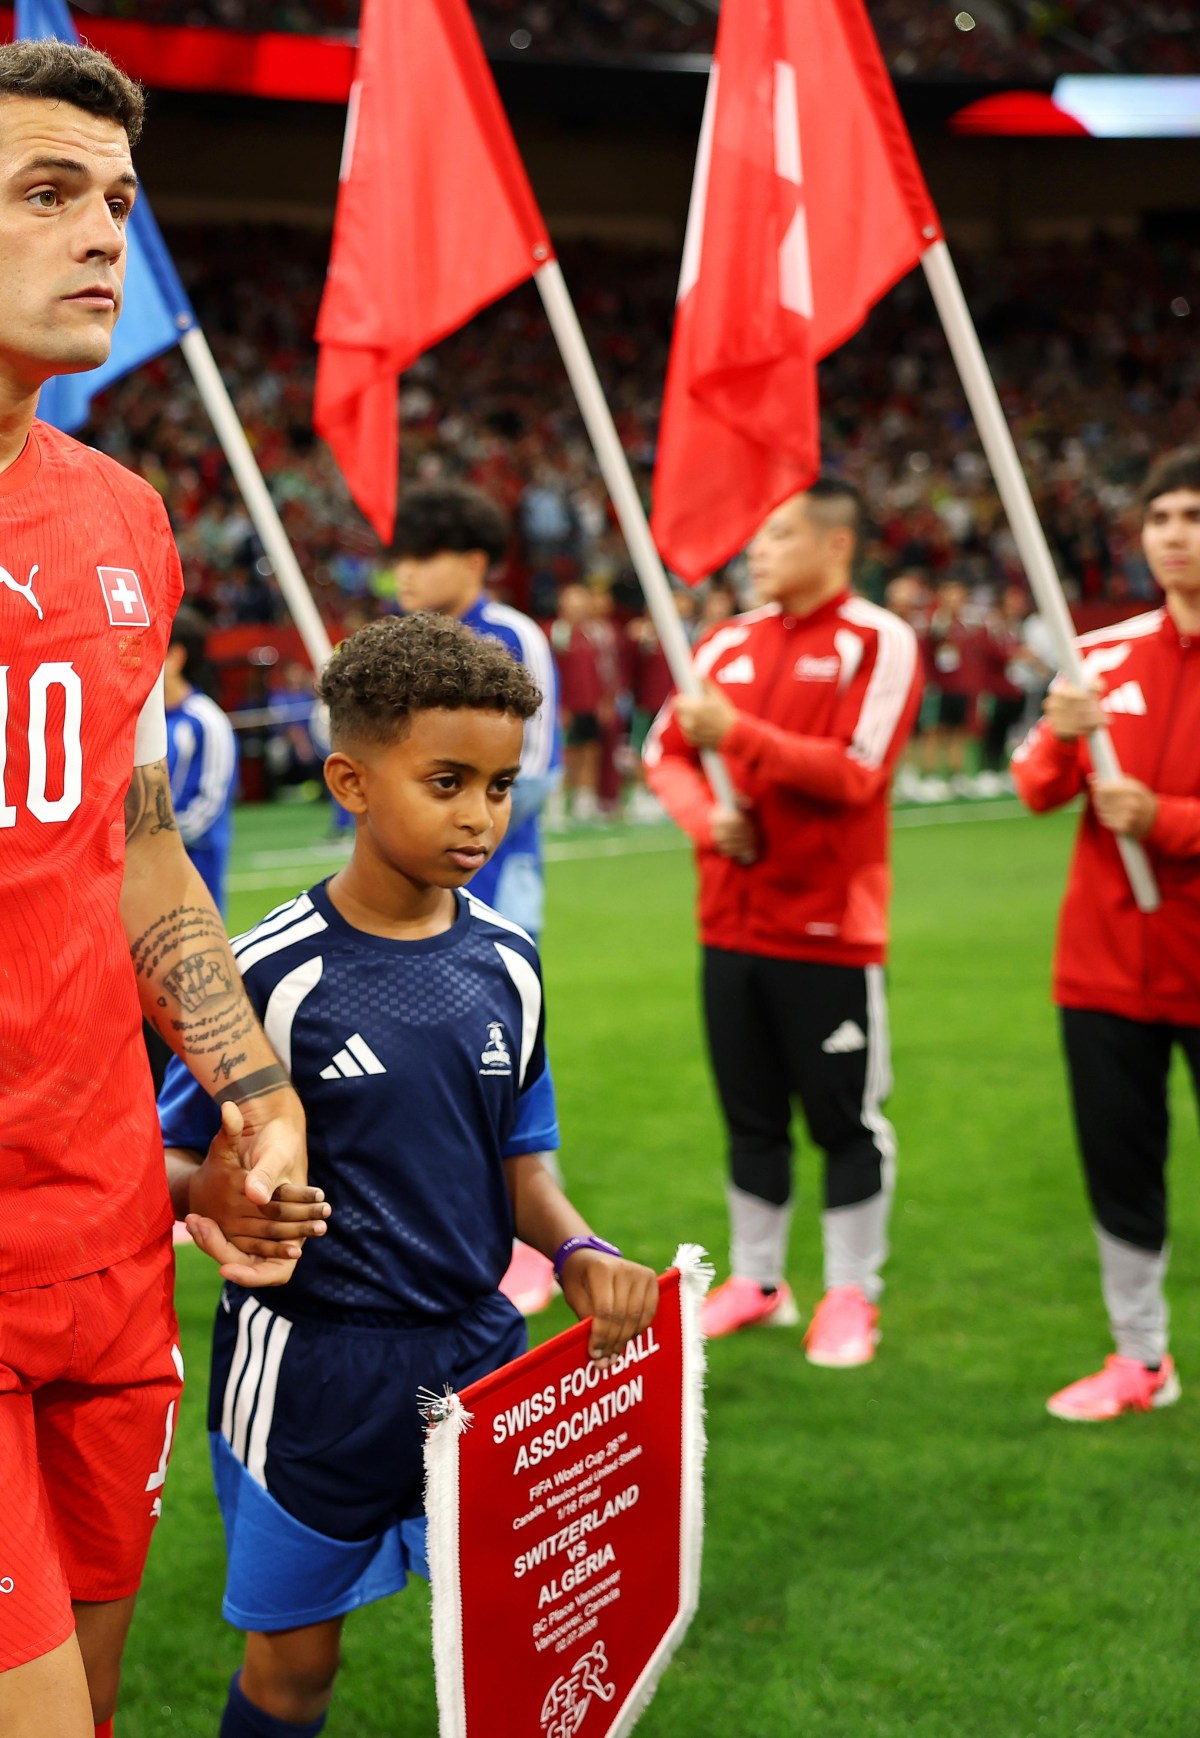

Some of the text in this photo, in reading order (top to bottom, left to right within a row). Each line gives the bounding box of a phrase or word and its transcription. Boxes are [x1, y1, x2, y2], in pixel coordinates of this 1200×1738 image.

[492, 1385, 557, 1445] SWISS
[513, 1375, 644, 1476] ASSOCIATION
[529, 1477, 553, 1501] FIFA
[554, 1460, 584, 1486] World
[585, 1450, 606, 1469] Cup
[547, 1486, 577, 1509] Mexico
[577, 1475, 593, 1492] and
[593, 1458, 619, 1482] United
[557, 1484, 602, 1520] 1/16 Final
[513, 1484, 640, 1578] SWITZERLAND
[537, 1543, 616, 1609] ALGERIA
[533, 1617, 548, 1637] BC
